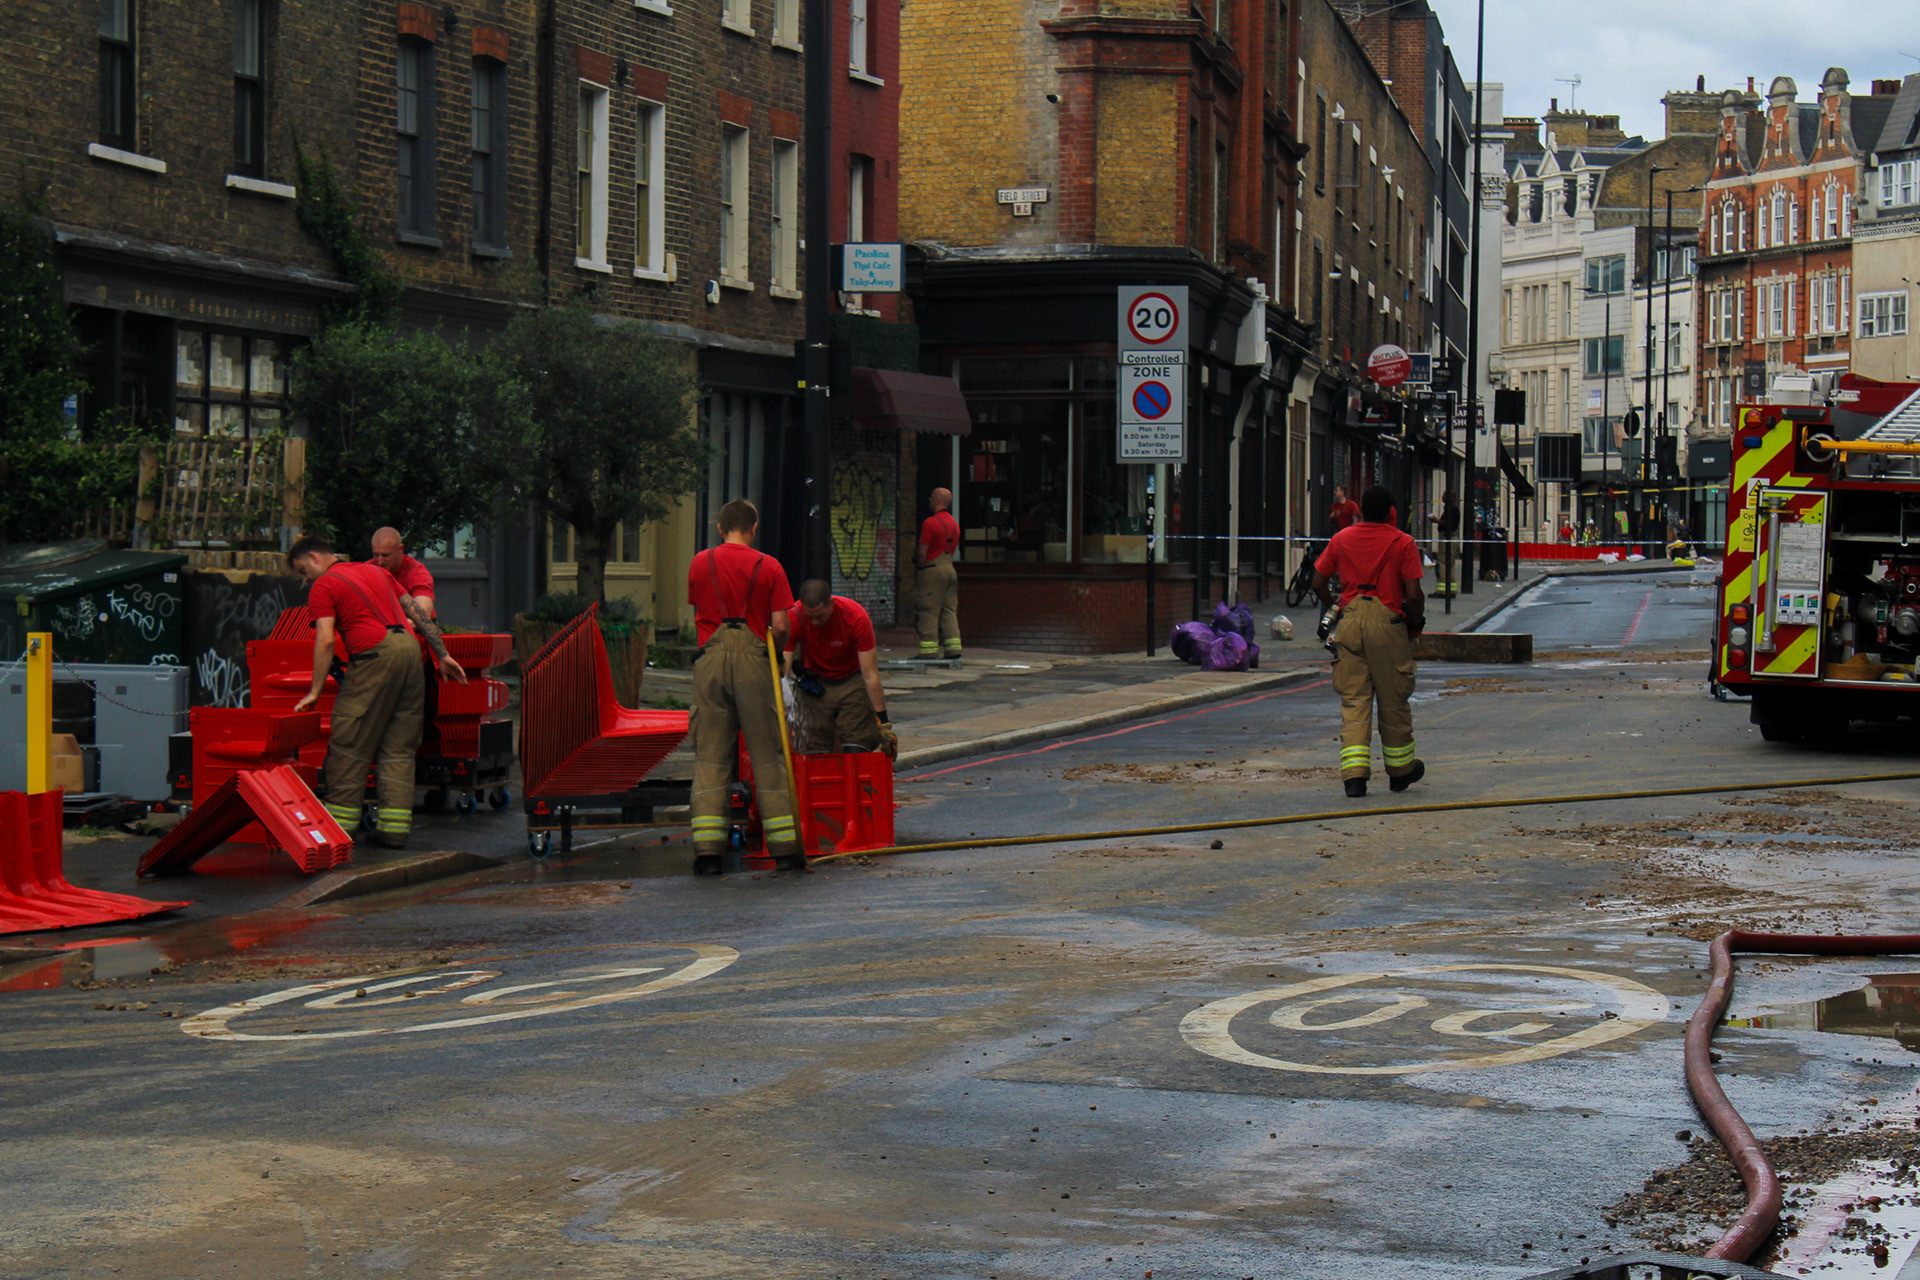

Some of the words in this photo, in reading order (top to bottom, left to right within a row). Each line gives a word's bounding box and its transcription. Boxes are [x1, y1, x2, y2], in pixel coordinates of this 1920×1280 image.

[1000, 191, 1018, 201] FIELD
[1022, 190, 1045, 200] STREET
[855, 249, 890, 258] Paolina
[853, 261, 871, 270] Thai
[873, 261, 891, 269] Cafe
[868, 270, 875, 278] &
[849, 277, 895, 288] Take-Away
[135, 290, 176, 309] Peter
[189, 298, 238, 319] Barber
[1136, 307, 1171, 329] 20
[1127, 354, 1180, 363] Controlled
[1133, 367, 1171, 378] ZONE
